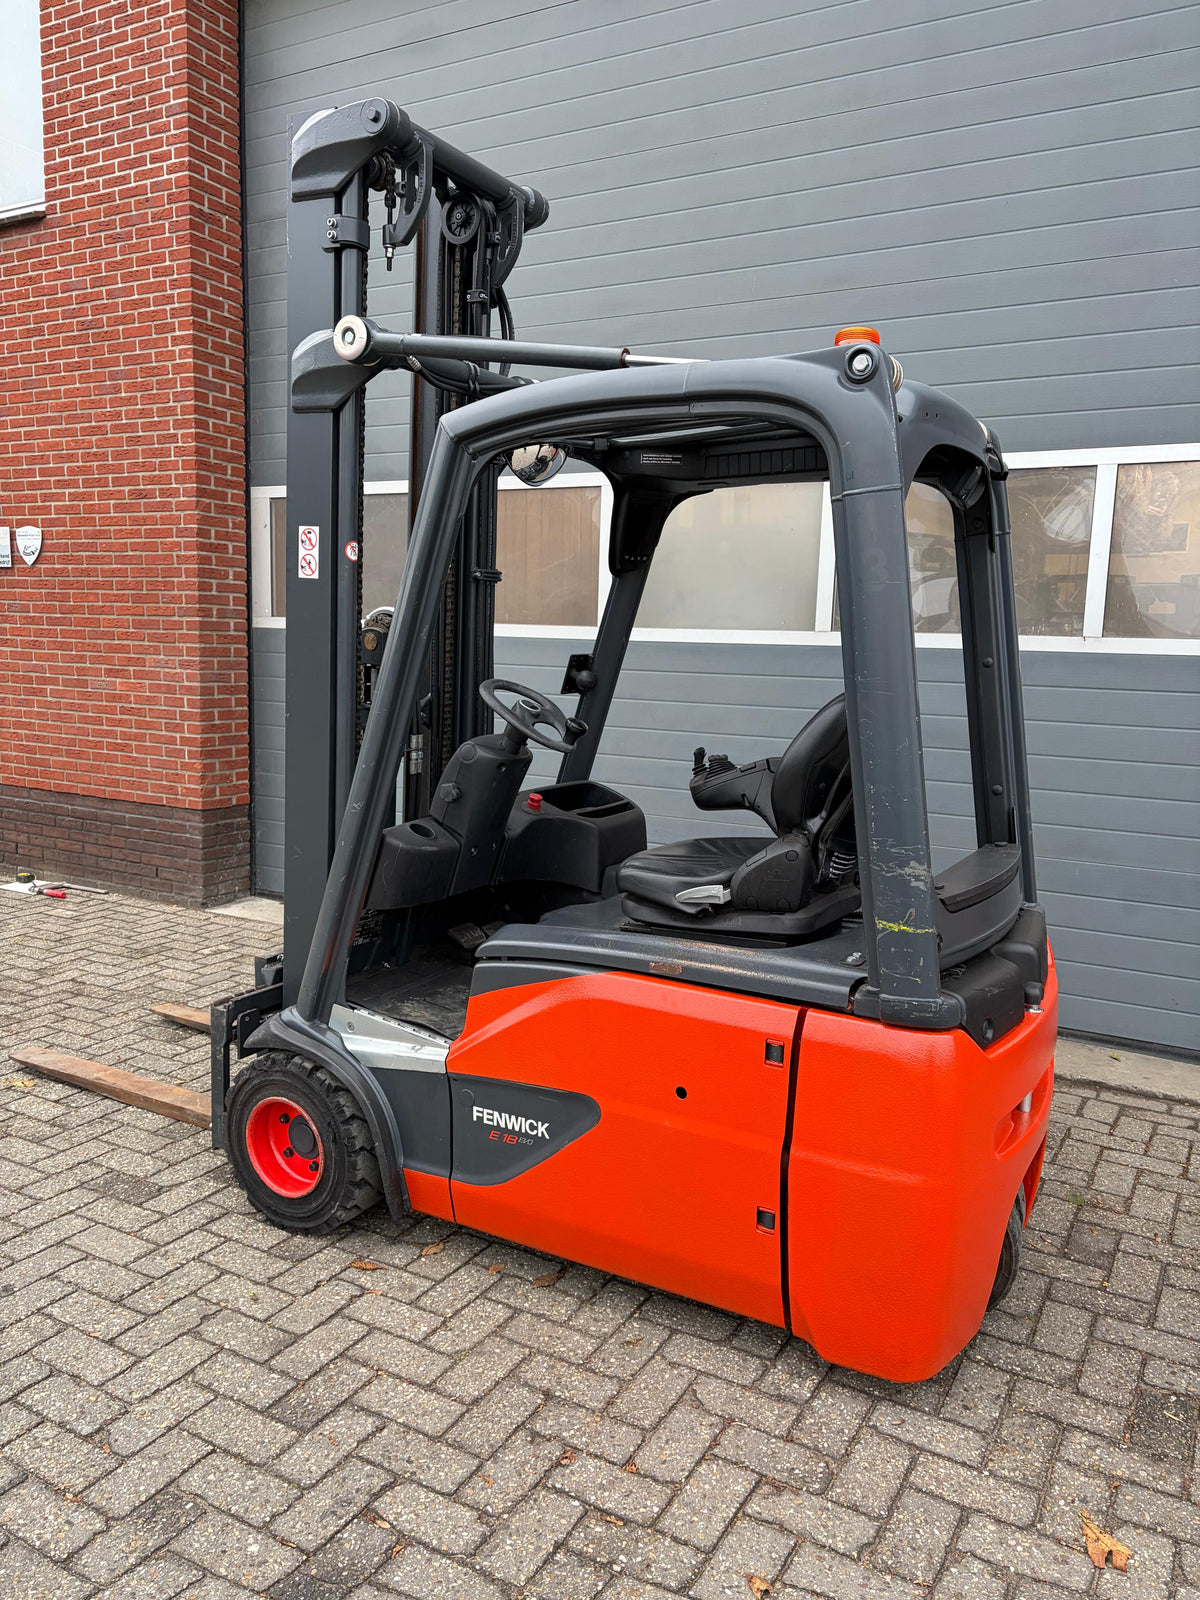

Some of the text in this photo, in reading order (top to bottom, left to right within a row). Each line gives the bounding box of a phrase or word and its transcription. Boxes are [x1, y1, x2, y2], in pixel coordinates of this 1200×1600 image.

[472, 1105, 550, 1139] FENWICK
[488, 1130, 501, 1141] E
[502, 1133, 519, 1145] 18
